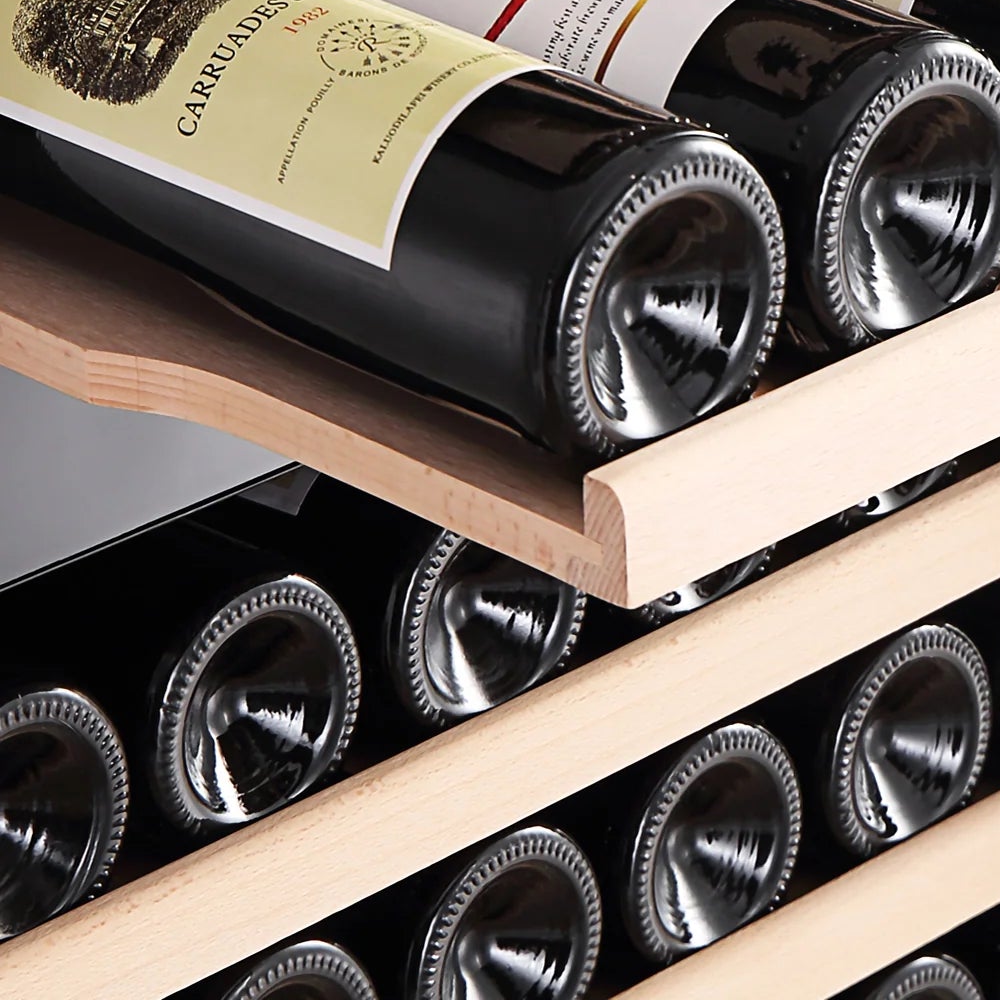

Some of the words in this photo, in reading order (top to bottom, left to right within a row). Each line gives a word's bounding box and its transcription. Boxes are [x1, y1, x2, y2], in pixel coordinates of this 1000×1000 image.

[283, 6, 329, 34] 1982
[581, 36, 599, 63] wine
[338, 66, 388, 78] BARONS
[278, 117, 309, 184] APPELLATION
[307, 77, 335, 114] POUILLY
